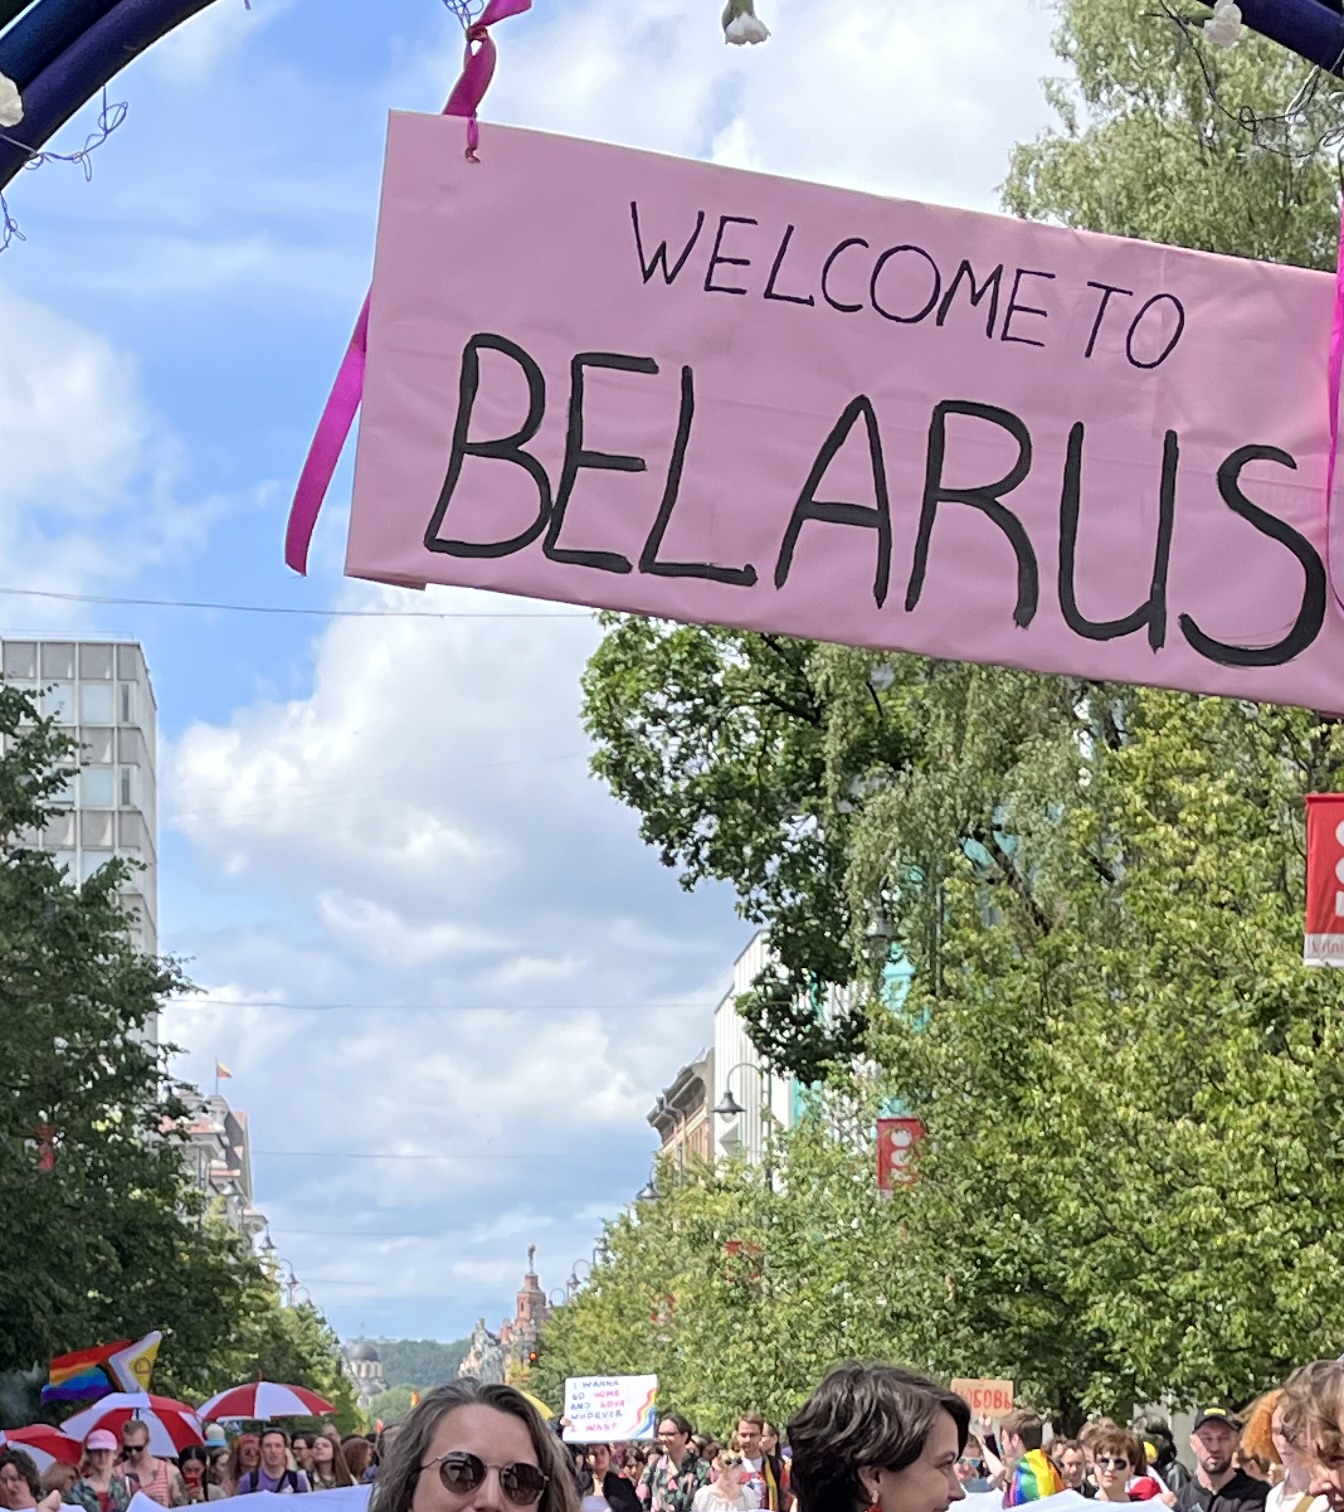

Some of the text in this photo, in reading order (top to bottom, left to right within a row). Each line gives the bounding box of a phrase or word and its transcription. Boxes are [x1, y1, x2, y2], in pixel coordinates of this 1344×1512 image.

[631, 200, 1185, 369] WELCOME TO
[423, 332, 1327, 668] BELARUS
[570, 1402, 592, 1411] AND
